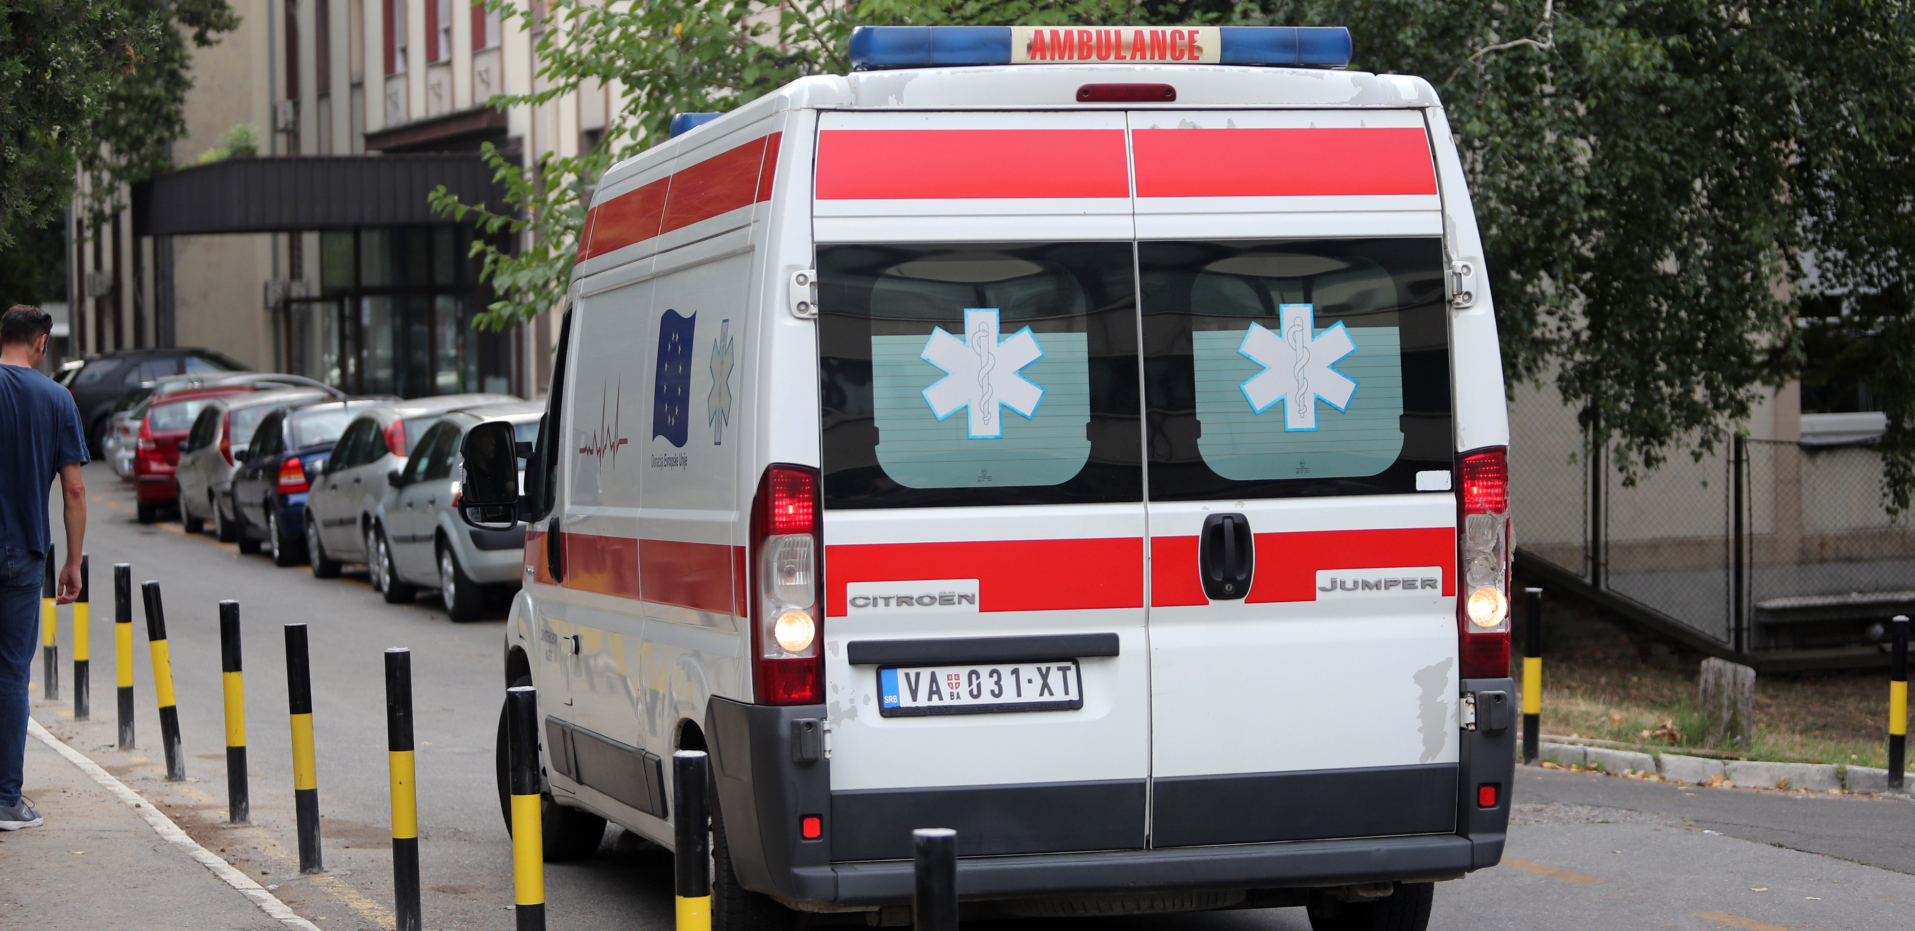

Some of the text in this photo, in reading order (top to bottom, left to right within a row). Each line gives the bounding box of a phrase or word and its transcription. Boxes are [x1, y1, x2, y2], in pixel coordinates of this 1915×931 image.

[1030, 29, 1200, 61] AMBULANCE
[1318, 577, 1438, 592] JUMPER
[849, 591, 976, 608] CITROËN
[904, 671, 944, 702] VA
[884, 695, 899, 704] SRB
[950, 691, 961, 701] BA
